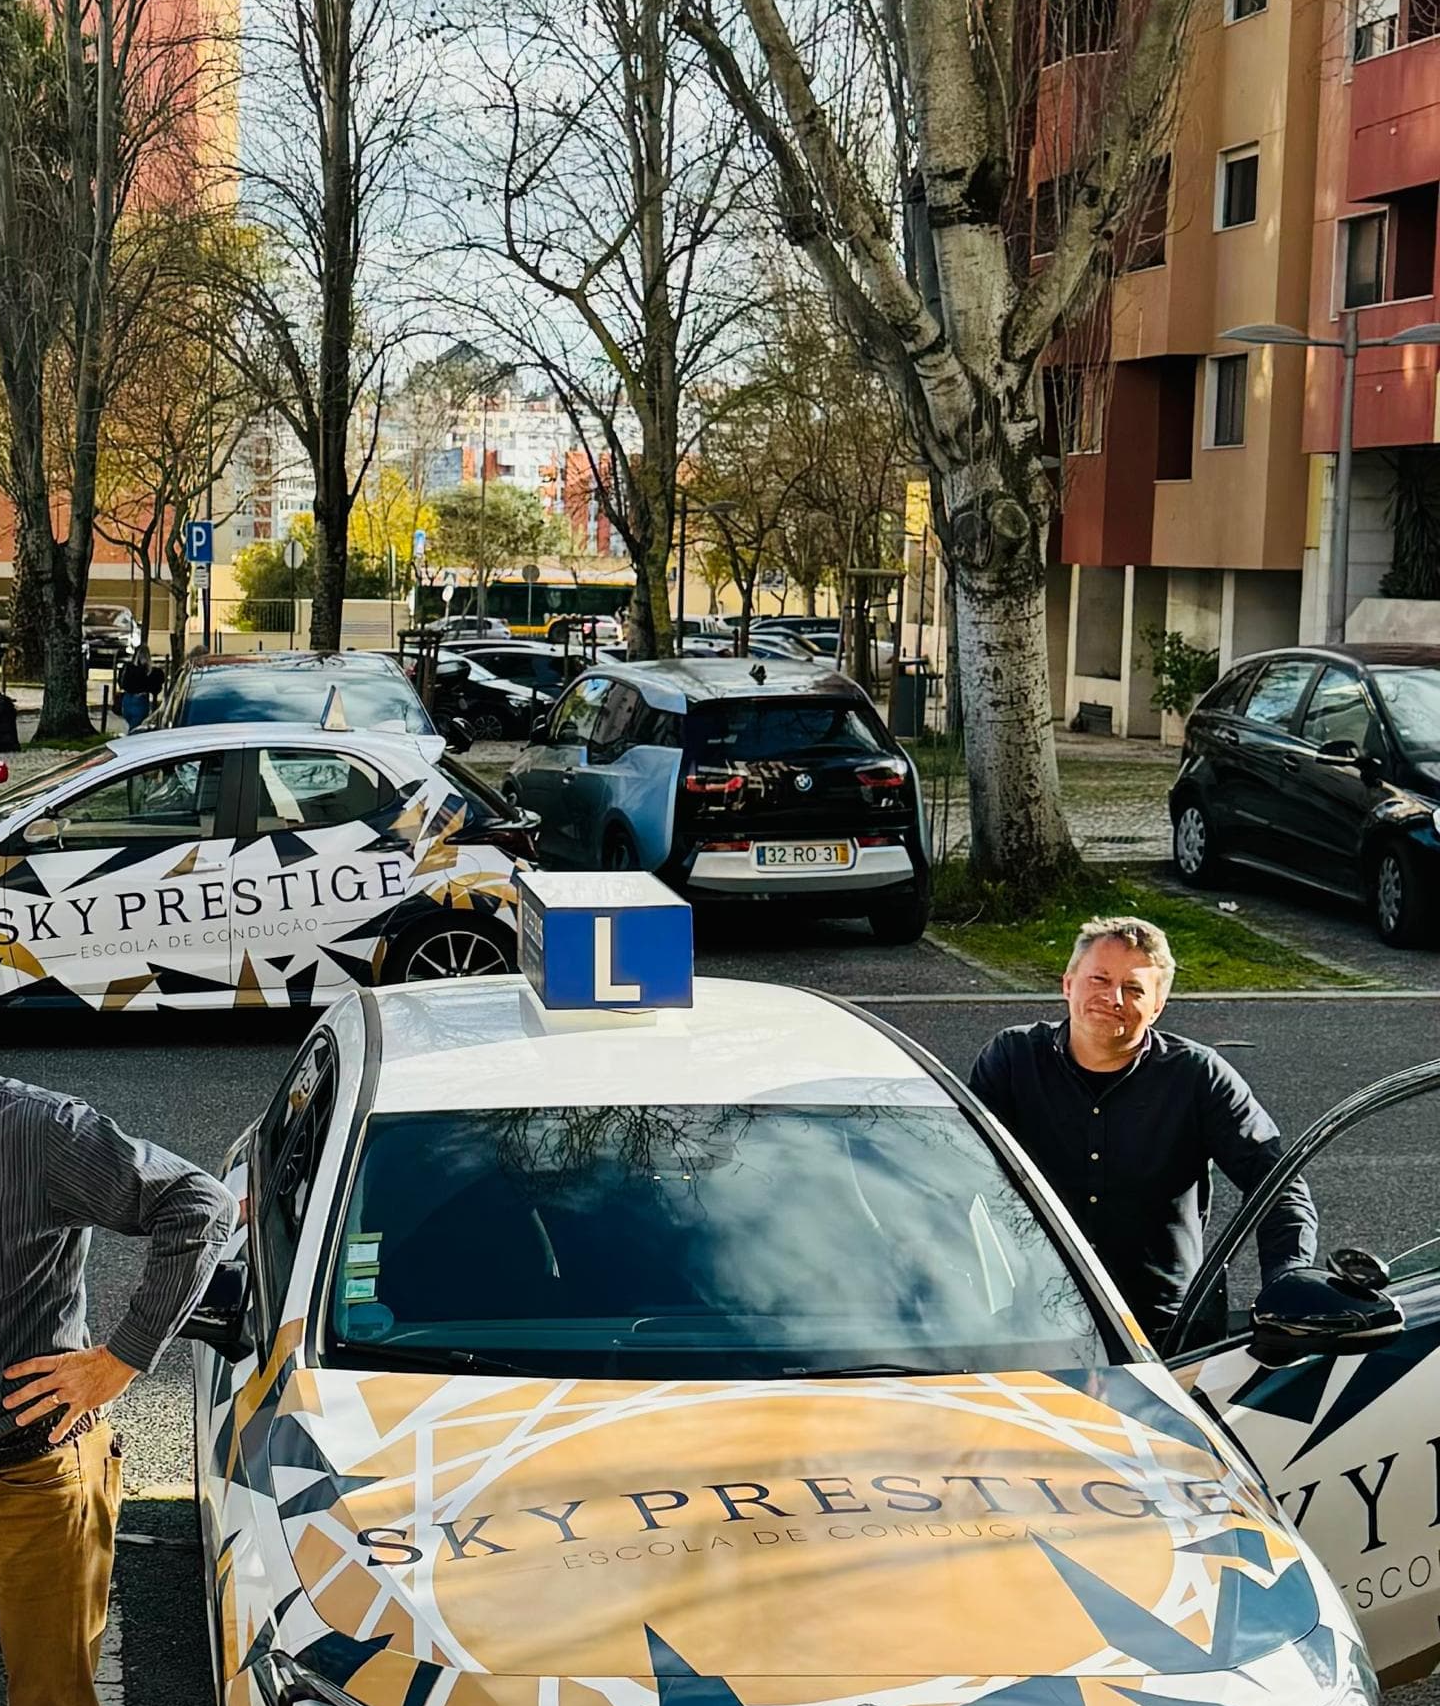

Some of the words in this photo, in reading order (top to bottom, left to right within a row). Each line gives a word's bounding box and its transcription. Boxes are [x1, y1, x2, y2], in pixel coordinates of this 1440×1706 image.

[192, 526, 206, 557] P
[114, 860, 407, 932] PRESTIGE
[81, 938, 158, 959] ESCOLA
[169, 932, 193, 949] DE
[200, 917, 319, 944] CONDUÇÃO
[595, 917, 640, 1002] L
[357, 1499, 587, 1568] SKY
[619, 1475, 1248, 1532] PRESTIGE
[563, 1535, 734, 1570] ESCOLA
[754, 1527, 809, 1545] DE
